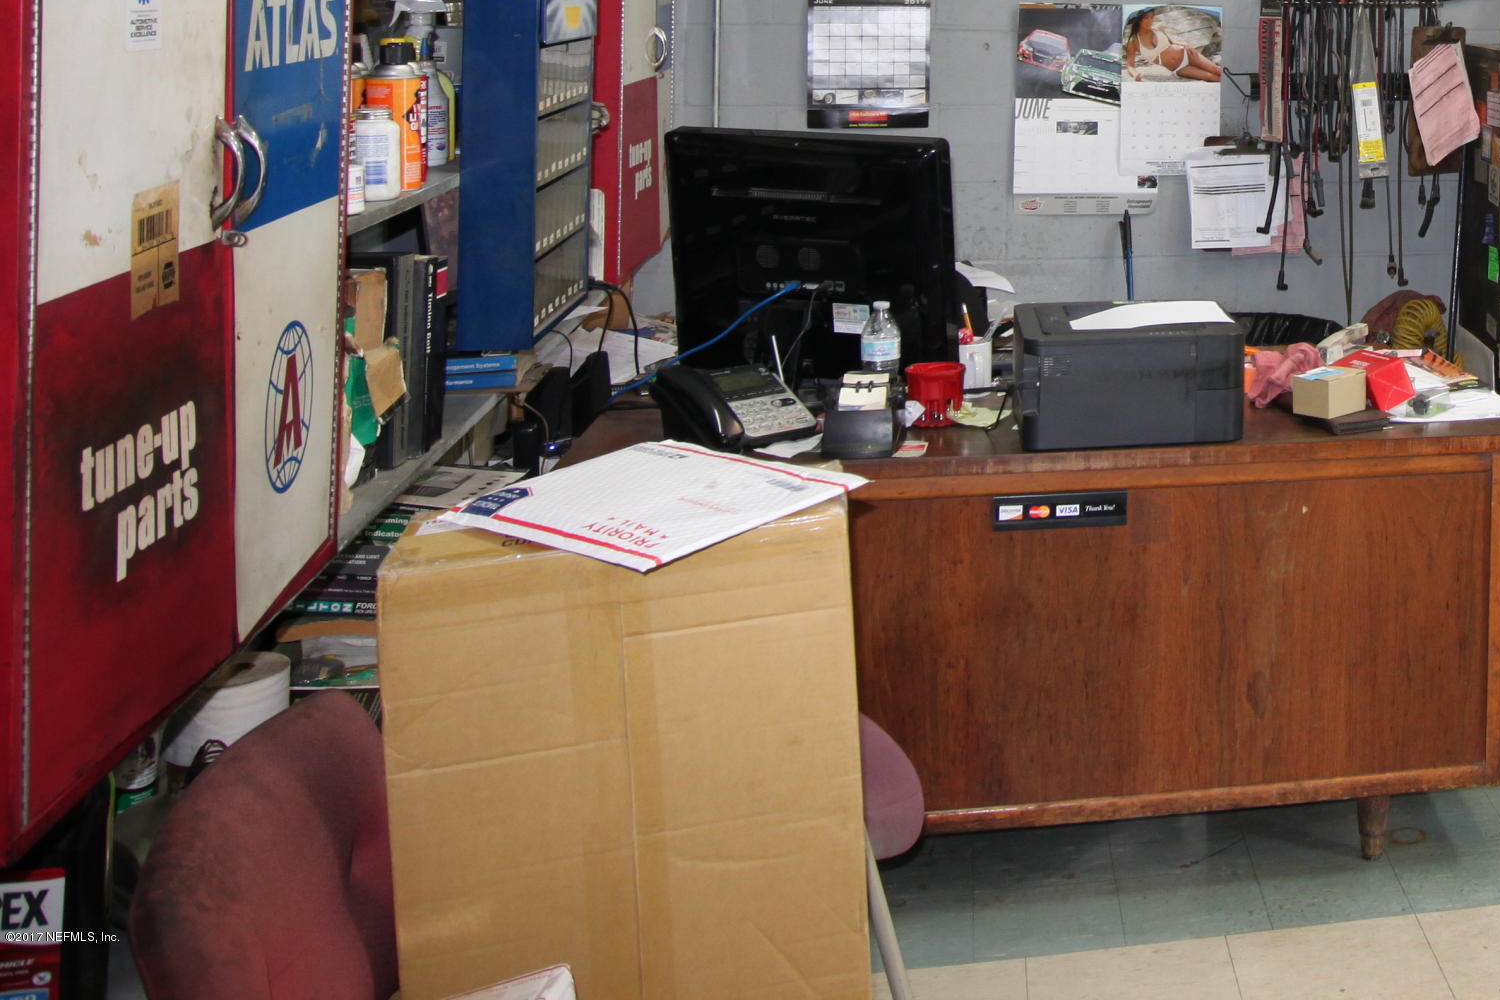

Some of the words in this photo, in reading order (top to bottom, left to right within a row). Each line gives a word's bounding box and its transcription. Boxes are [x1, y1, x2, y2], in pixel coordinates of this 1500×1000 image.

[1015, 98, 1053, 120] JUNE
[80, 400, 197, 512] tune-up
[1059, 506, 1078, 514] VISA
[1085, 505, 1102, 513] Thank
[116, 467, 199, 583] parts
[583, 521, 661, 549] PRIORITY
[620, 519, 660, 537] MAIL
[0, 888, 49, 931] EX
